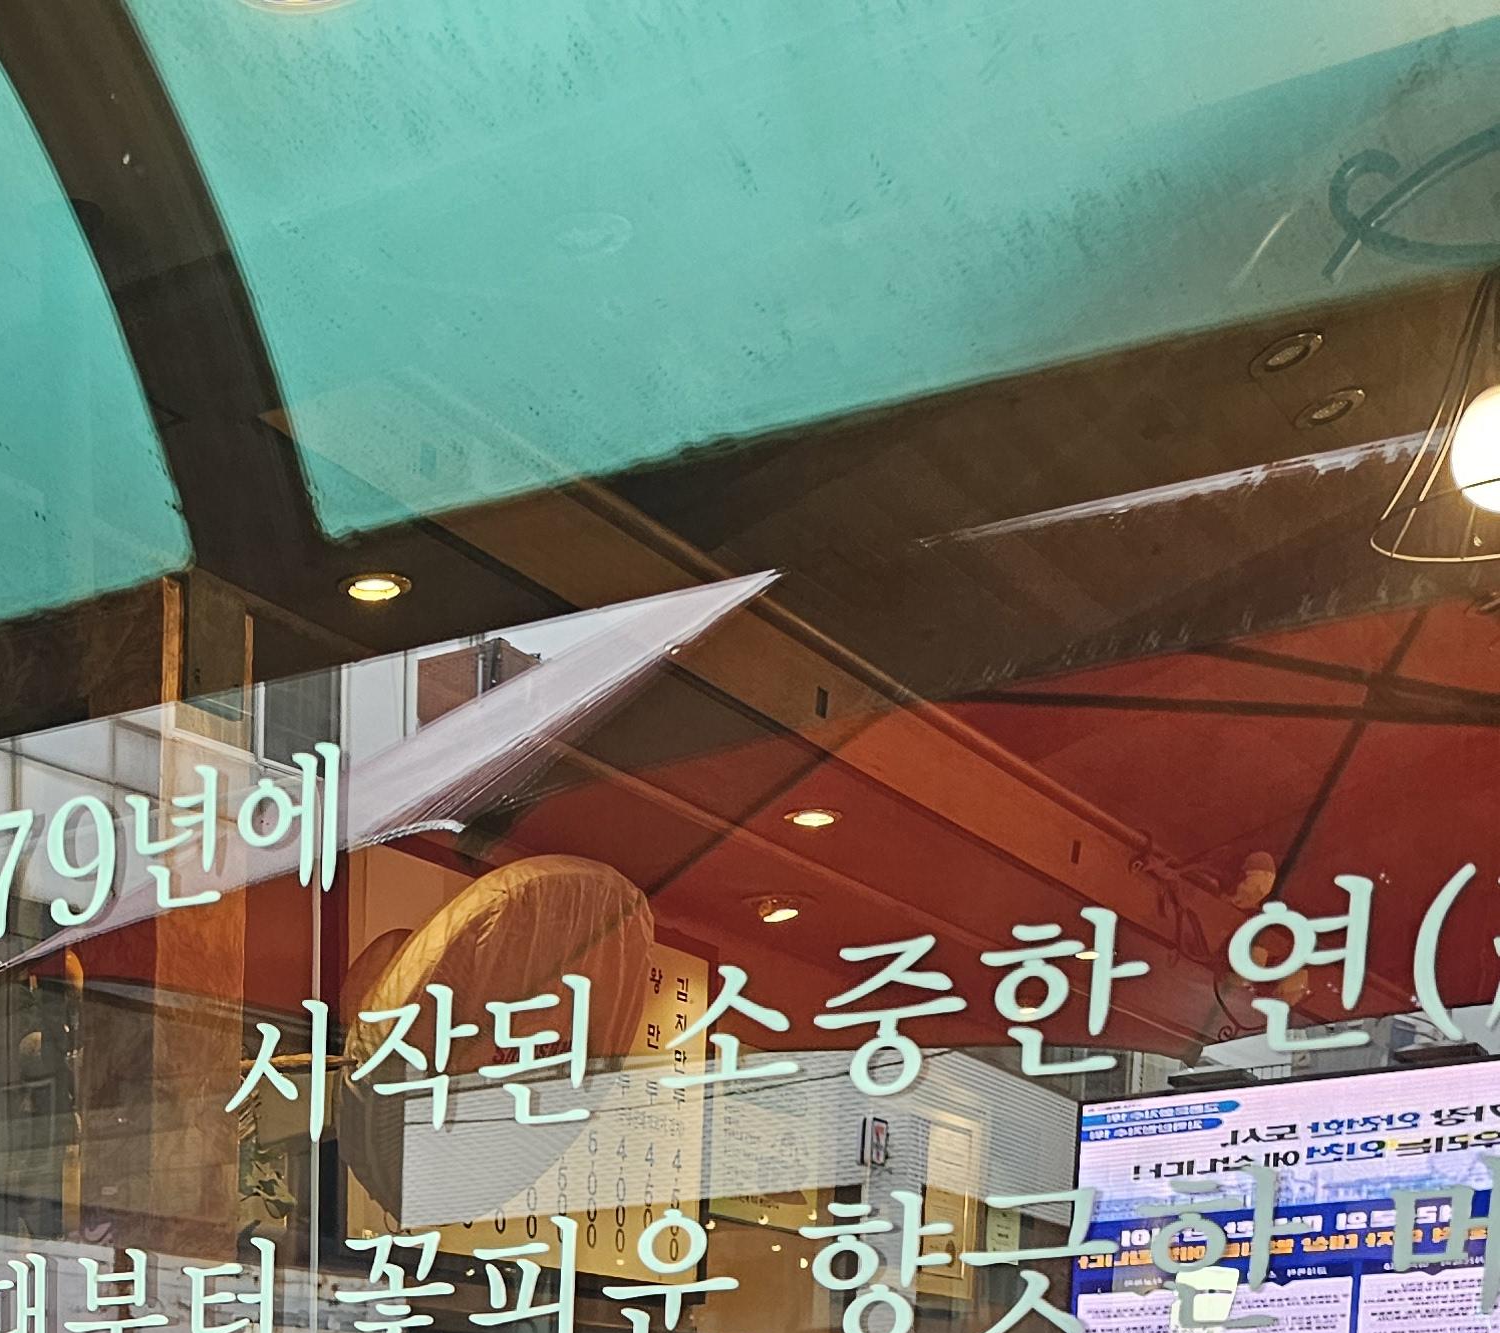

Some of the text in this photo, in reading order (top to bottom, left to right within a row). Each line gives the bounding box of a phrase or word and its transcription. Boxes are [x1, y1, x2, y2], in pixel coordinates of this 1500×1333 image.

[226, 973, 591, 1142] 시작된
[658, 907, 1149, 1097] 소중한
[1228, 863, 1500, 1052] 연(
